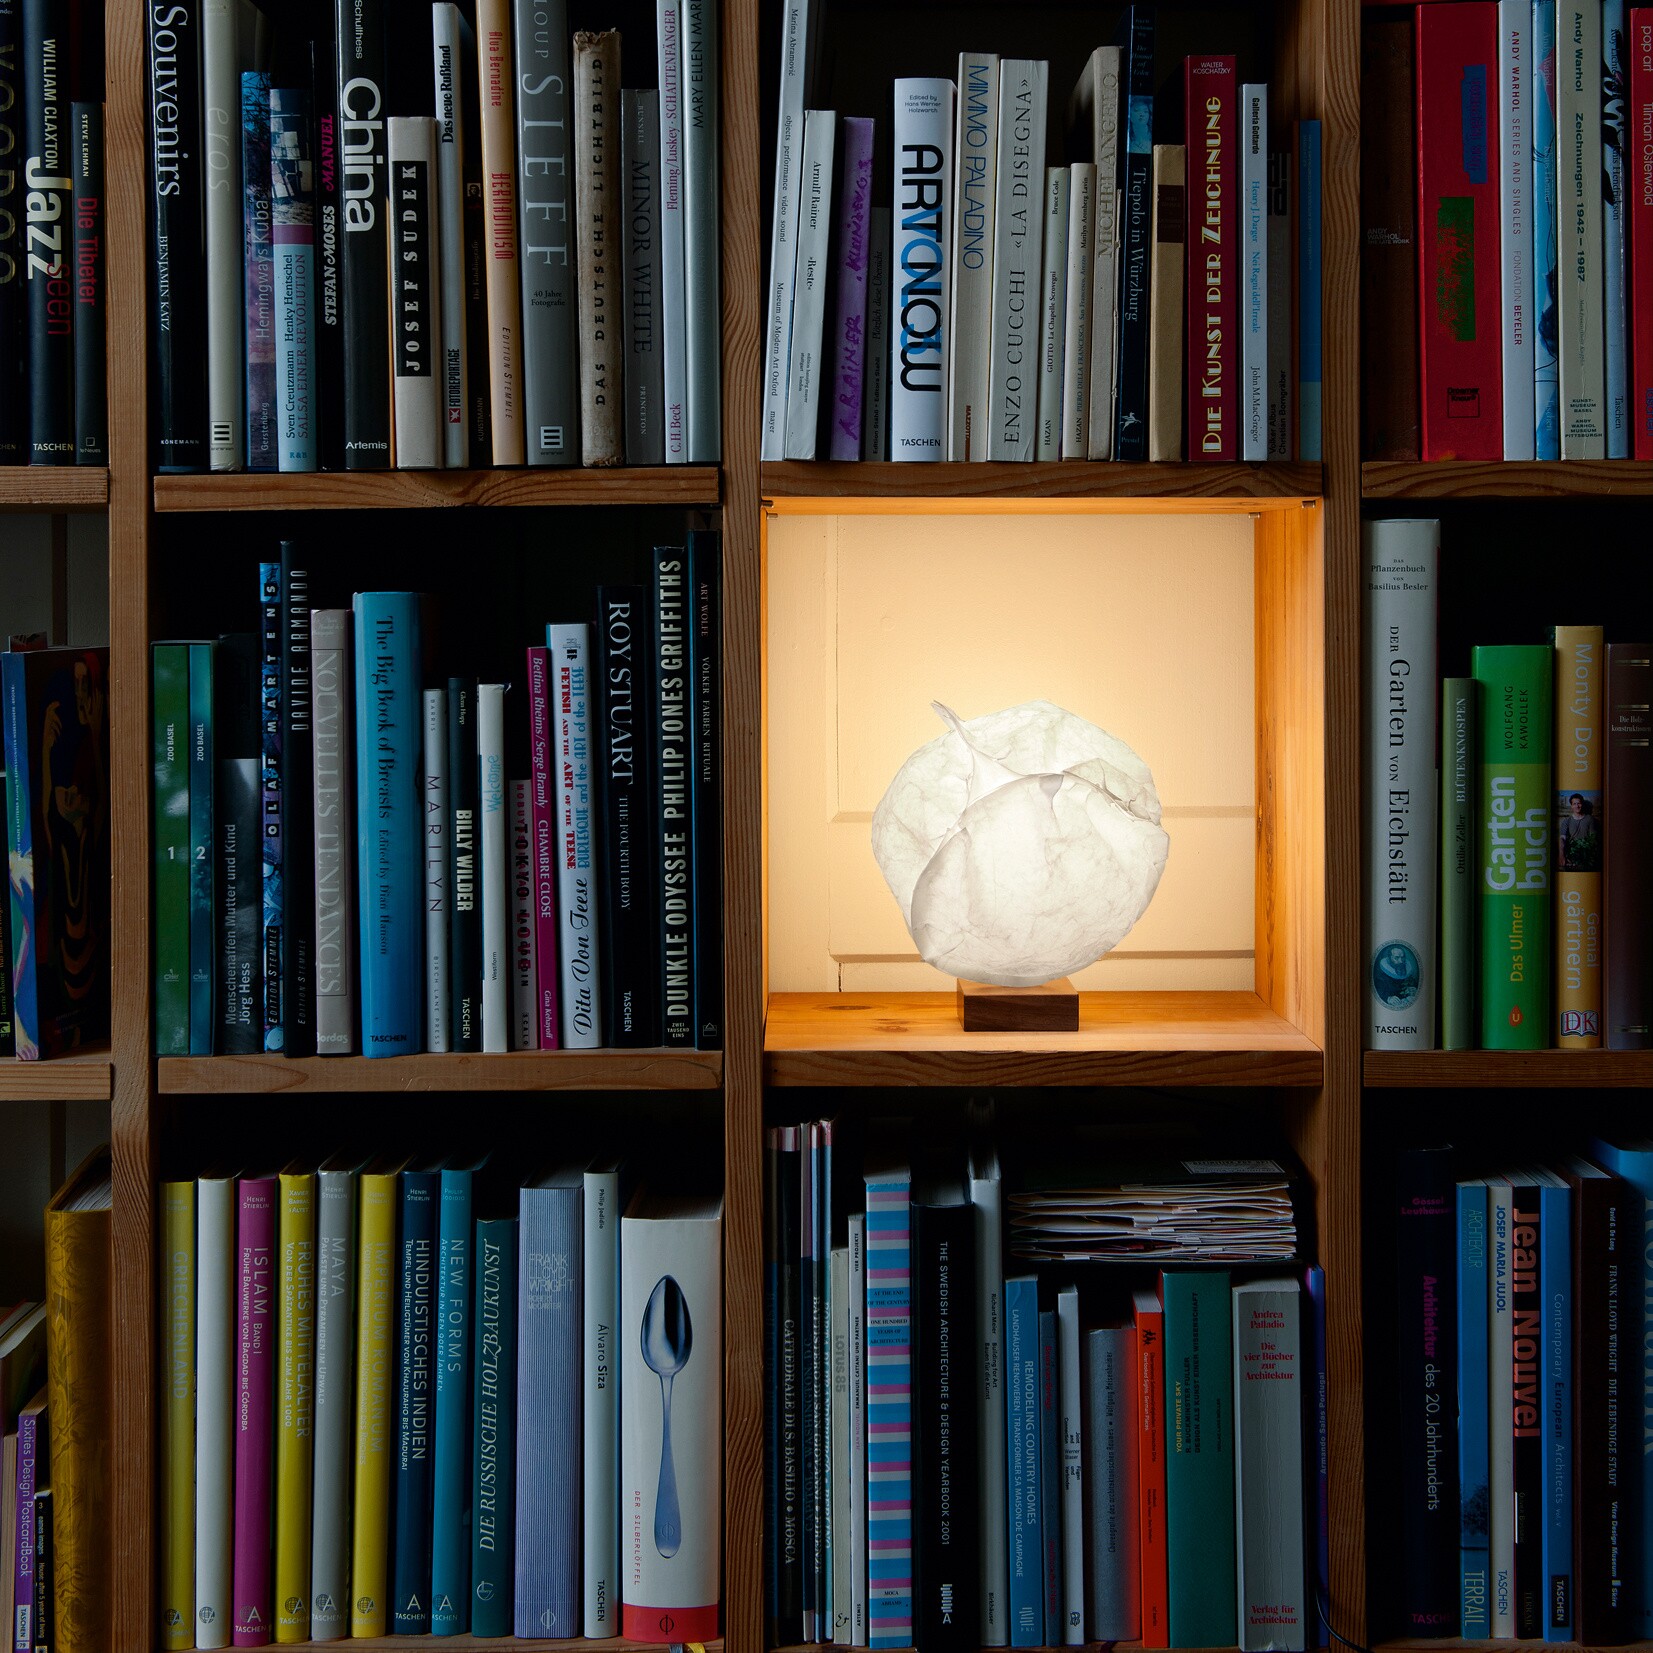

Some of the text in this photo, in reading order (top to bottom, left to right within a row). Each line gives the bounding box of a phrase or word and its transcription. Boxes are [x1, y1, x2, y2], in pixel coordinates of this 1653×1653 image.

[154, 5, 189, 196] Souvenirs
[439, 45, 453, 143] Das neue Rußland
[665, 10, 677, 119] SCHATTENFÄNGER
[788, 8, 799, 77] Marina Abramović
[25, 40, 72, 335] WILLIAM CLAXTON Jazz seen
[81, 114, 89, 140] STEVE
[342, 77, 384, 232] China
[522, 73, 567, 266] SIEFF
[811, 161, 822, 193] Arnulf
[963, 65, 989, 269] MIMMO PALADINO
[1511, 31, 1523, 345] ANDY WARHOL SERIES AND SINGLES BEYELER
[1573, 12, 1586, 282] Andy Warhol Zeichnungen 1942 1987
[77, 197, 97, 228] Die
[78, 236, 98, 307] Tibeter
[254, 200, 272, 338] Hemingways Kuba
[322, 206, 336, 325] STEFAN MOSES
[403, 166, 420, 371] JOSEF SUDEK
[592, 60, 607, 405] DAS DEUTSCHE LICHTBILD
[632, 158, 652, 353] MINOR WHITE
[810, 197, 821, 229] Rainer
[1125, 168, 1146, 320] Tiepolo in Würzburg
[1202, 97, 1221, 452] DIE KUNST DER ZEICHNUNG
[159, 236, 170, 331] BENJAMIN KATZ
[1007, 270, 1025, 364] CUCCHI
[900, 437, 942, 447] TASCHEN
[1004, 376, 1021, 442] ENZO
[266, 585, 279, 836] OLAF MARTENS
[290, 571, 307, 730] DAVIDE ARMANDO
[1570, 643, 1592, 772] Monty Don
[372, 620, 396, 818] The Big Book of Breasts
[1387, 626, 1412, 904] DER Garten VON Eichstätt
[427, 777, 442, 910] MARILYN
[609, 601, 633, 1032] ROY STUART TASCHEN
[659, 561, 688, 1015] DUNKLE ODYSSEE PHILIP JONES GRIFFITHS
[1486, 777, 1515, 890] Garten
[1521, 808, 1546, 889] buch
[456, 810, 472, 910] BILLY WILDER
[540, 820, 553, 918] CHAMBRE CLOSE
[239, 963, 252, 1024] Jörg Hess
[1509, 904, 1524, 981] Das Ulmer
[1563, 890, 1585, 989] gärtnern
[1586, 912, 1598, 968] Genial
[369, 1034, 408, 1043] TASCHEN
[1374, 1025, 1418, 1035] TASCHEN
[254, 1249, 266, 1313] ISLAM
[448, 1239, 465, 1371] NEW FORMS
[939, 1241, 948, 1262] THE
[939, 1265, 949, 1316] SWEDISH
[296, 1241, 313, 1438] FRÜHES MITTELALTER
[412, 1241, 429, 1458] HINDUISTISCHES INDIEN
[940, 1318, 949, 1399] ARCHITECTURE
[1513, 1207, 1540, 1437] Jean Nouvel
[1608, 1265, 1618, 1487] FRANK LLOYD WRIGHT DIE LEBENDIGE STADT
[480, 1239, 501, 1551] DIE RUSSISCHE HOLZBAUKUNST
[784, 1319, 795, 1563] CATTEDRALE DI S. BASILIO MOSCA
[940, 1414, 950, 1455] DESIGN
[1024, 1360, 1036, 1525] REMODELING COUNTRY HOMES
[1421, 1275, 1442, 1510] Architektur des 20. Jahrhunderts
[1496, 1205, 1508, 1617] JOSEP MARIA JUJOL TASCHEN
[1552, 1294, 1566, 1504] Contemporary European Architects
[19, 1420, 35, 1576] Sixties Design PostcardBook
[597, 1324, 609, 1622] Álvaro Siza TASCHEN
[633, 1490, 643, 1586] DER SILBERLÖFFEL
[941, 1458, 950, 1517] YEARBOOK
[941, 1520, 950, 1545] 2001
[1465, 1570, 1484, 1626] TERRAIL
